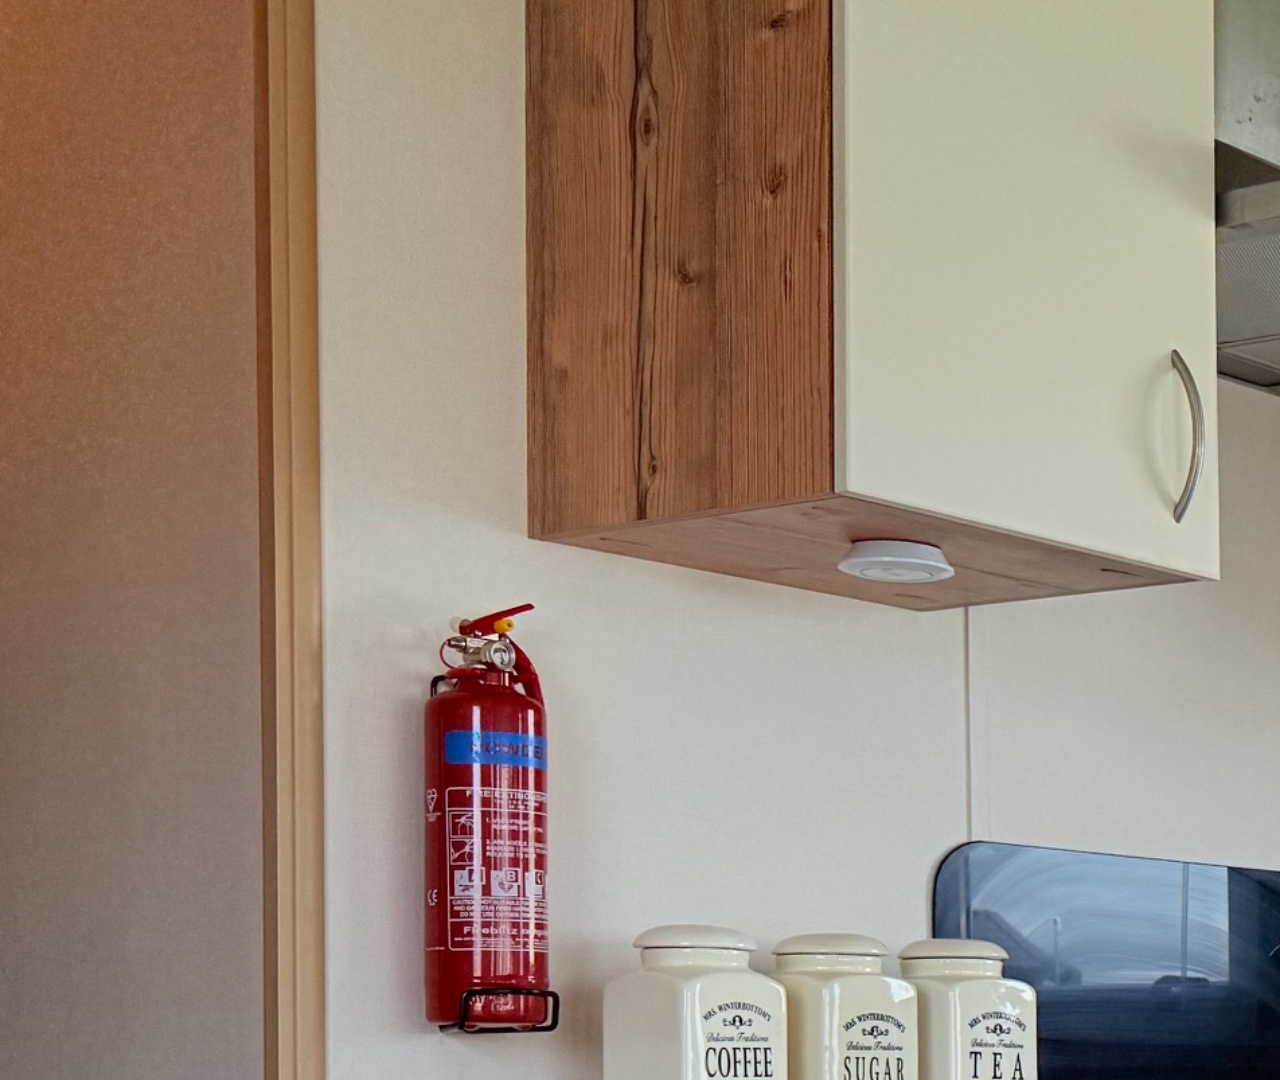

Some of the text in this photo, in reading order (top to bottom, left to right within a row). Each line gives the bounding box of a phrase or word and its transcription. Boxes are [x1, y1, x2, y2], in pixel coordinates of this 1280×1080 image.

[507, 870, 517, 880] B
[705, 1046, 773, 1078] COFFEE
[969, 1051, 1025, 1080] TEA
